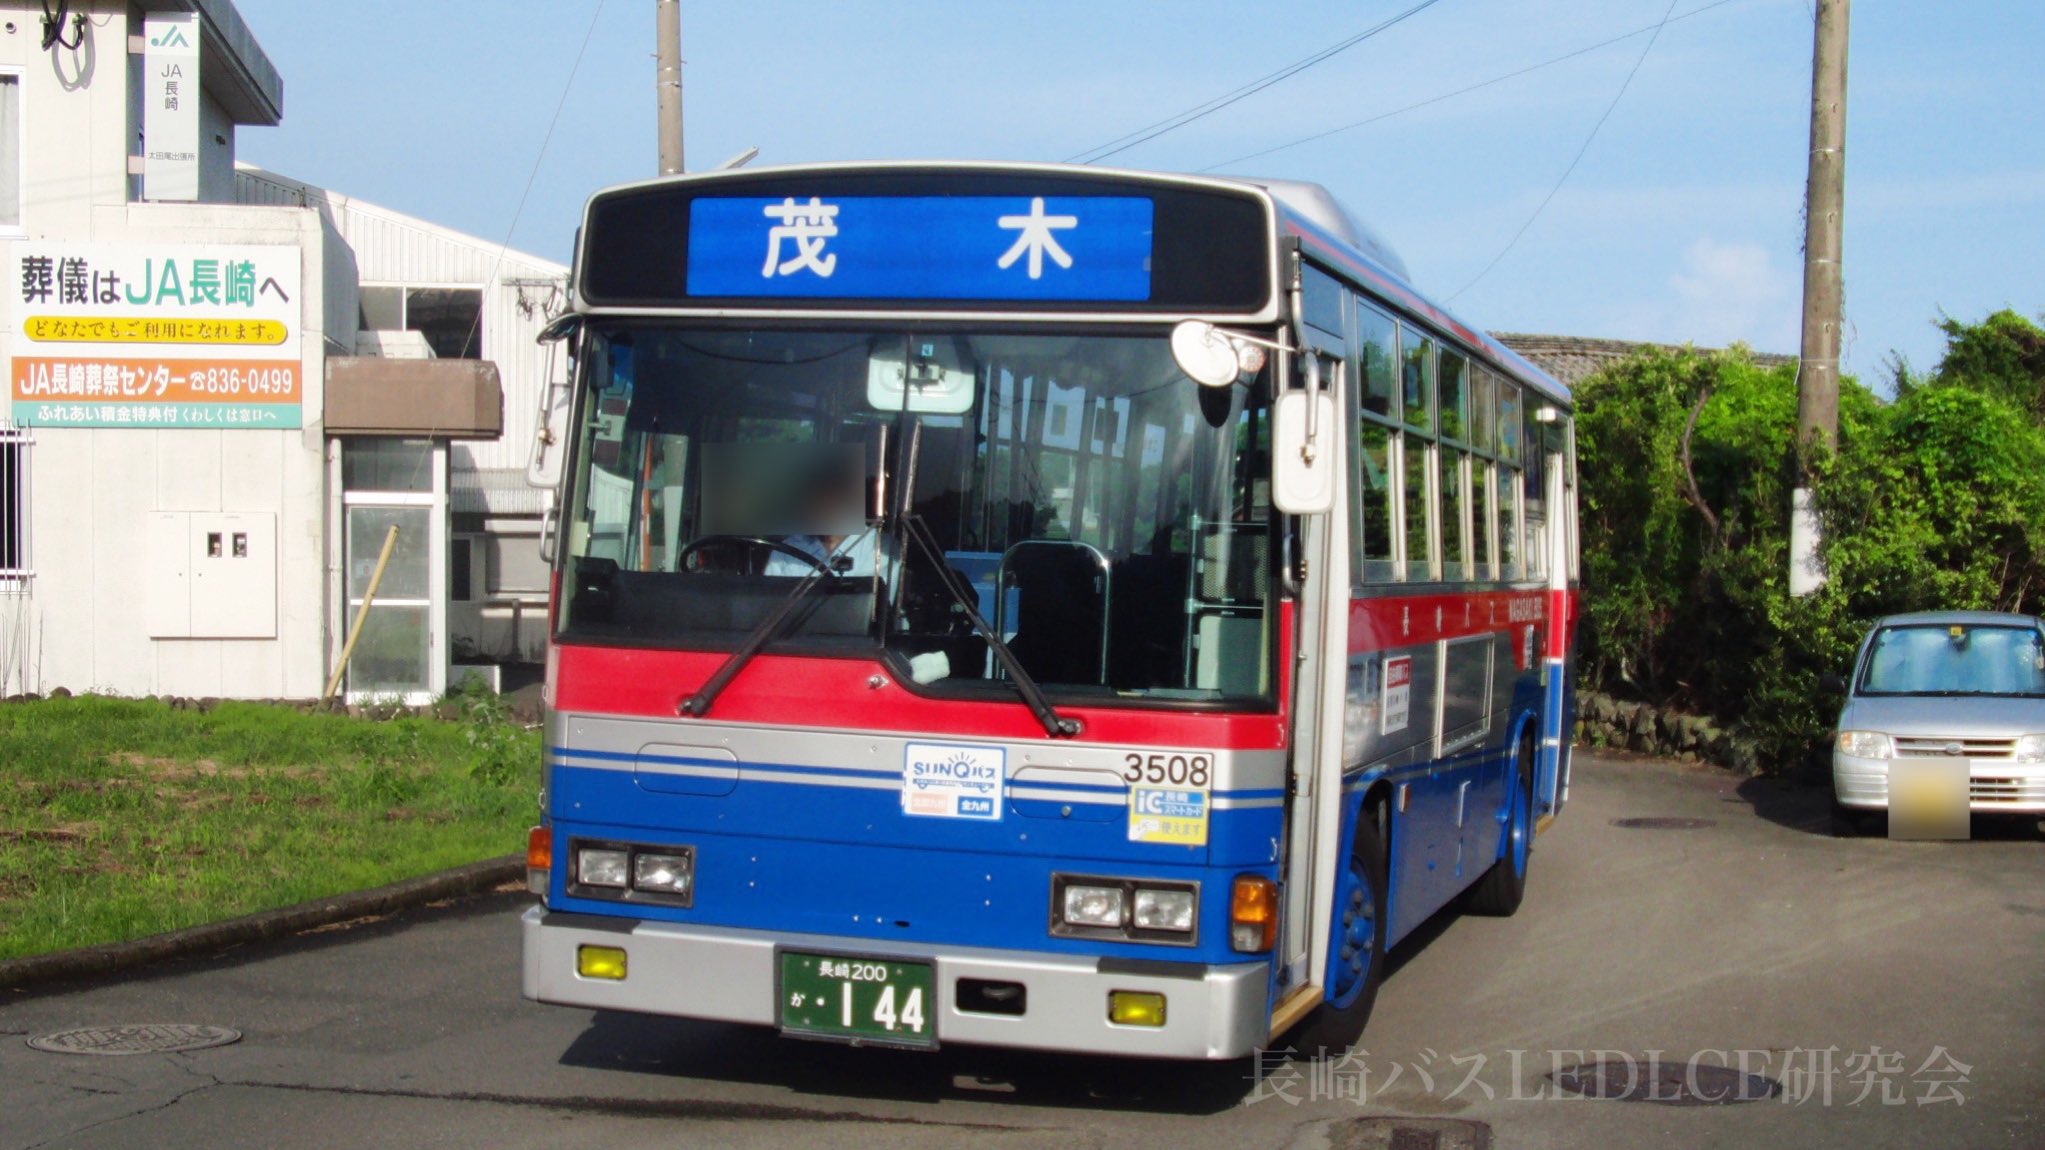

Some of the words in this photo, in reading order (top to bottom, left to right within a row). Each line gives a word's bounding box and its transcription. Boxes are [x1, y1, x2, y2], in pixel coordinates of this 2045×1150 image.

[22, 255, 289, 307] 葬儀はJA長崎へ
[35, 319, 274, 340] どなたでもご利用になれます。
[1123, 753, 1208, 787] 3508
[961, 799, 990, 813] 全九州
